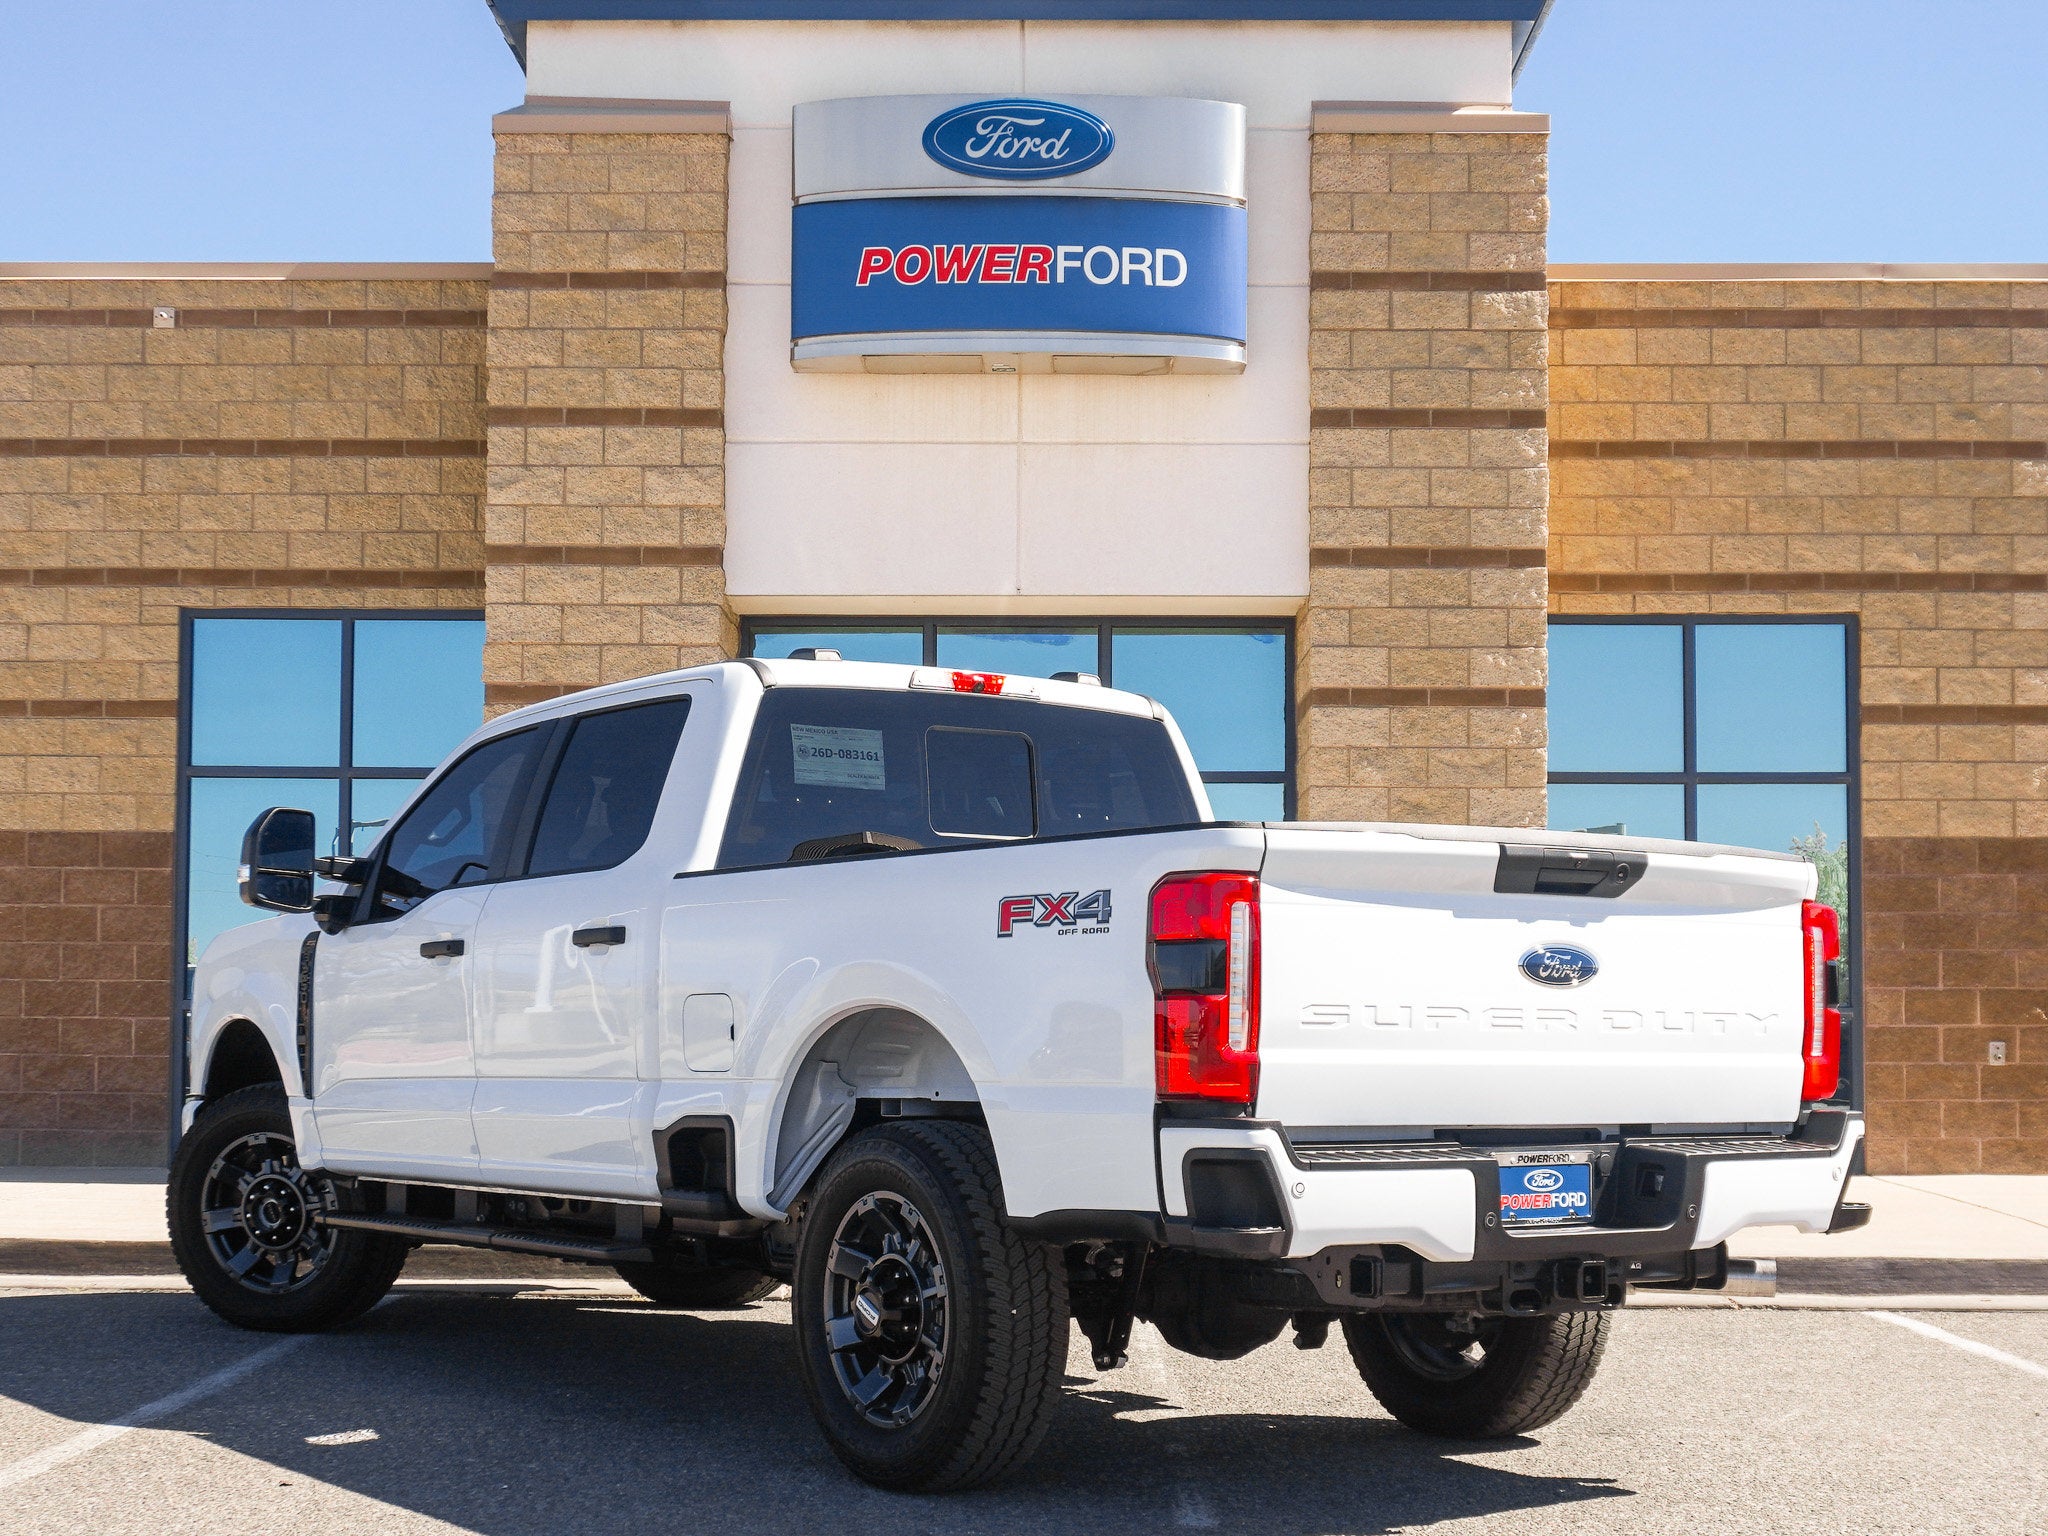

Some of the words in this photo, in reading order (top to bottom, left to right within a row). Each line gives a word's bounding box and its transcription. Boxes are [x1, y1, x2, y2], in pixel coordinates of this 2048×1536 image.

[964, 115, 1072, 160] Ford
[855, 243, 1188, 287] POWERFORD
[811, 747, 880, 761] 26D-083161
[997, 889, 1112, 938] FX4
[1057, 928, 1078, 936] OFF
[1081, 926, 1110, 935] ROAD
[1539, 951, 1583, 978] Ford
[1300, 1003, 1579, 1033] SUPER
[1602, 1008, 1780, 1037] DUTY
[1517, 1153, 1570, 1164] POWERFORD
[1531, 1173, 1556, 1187] Ford
[1500, 1191, 1587, 1210] POWERFORD
